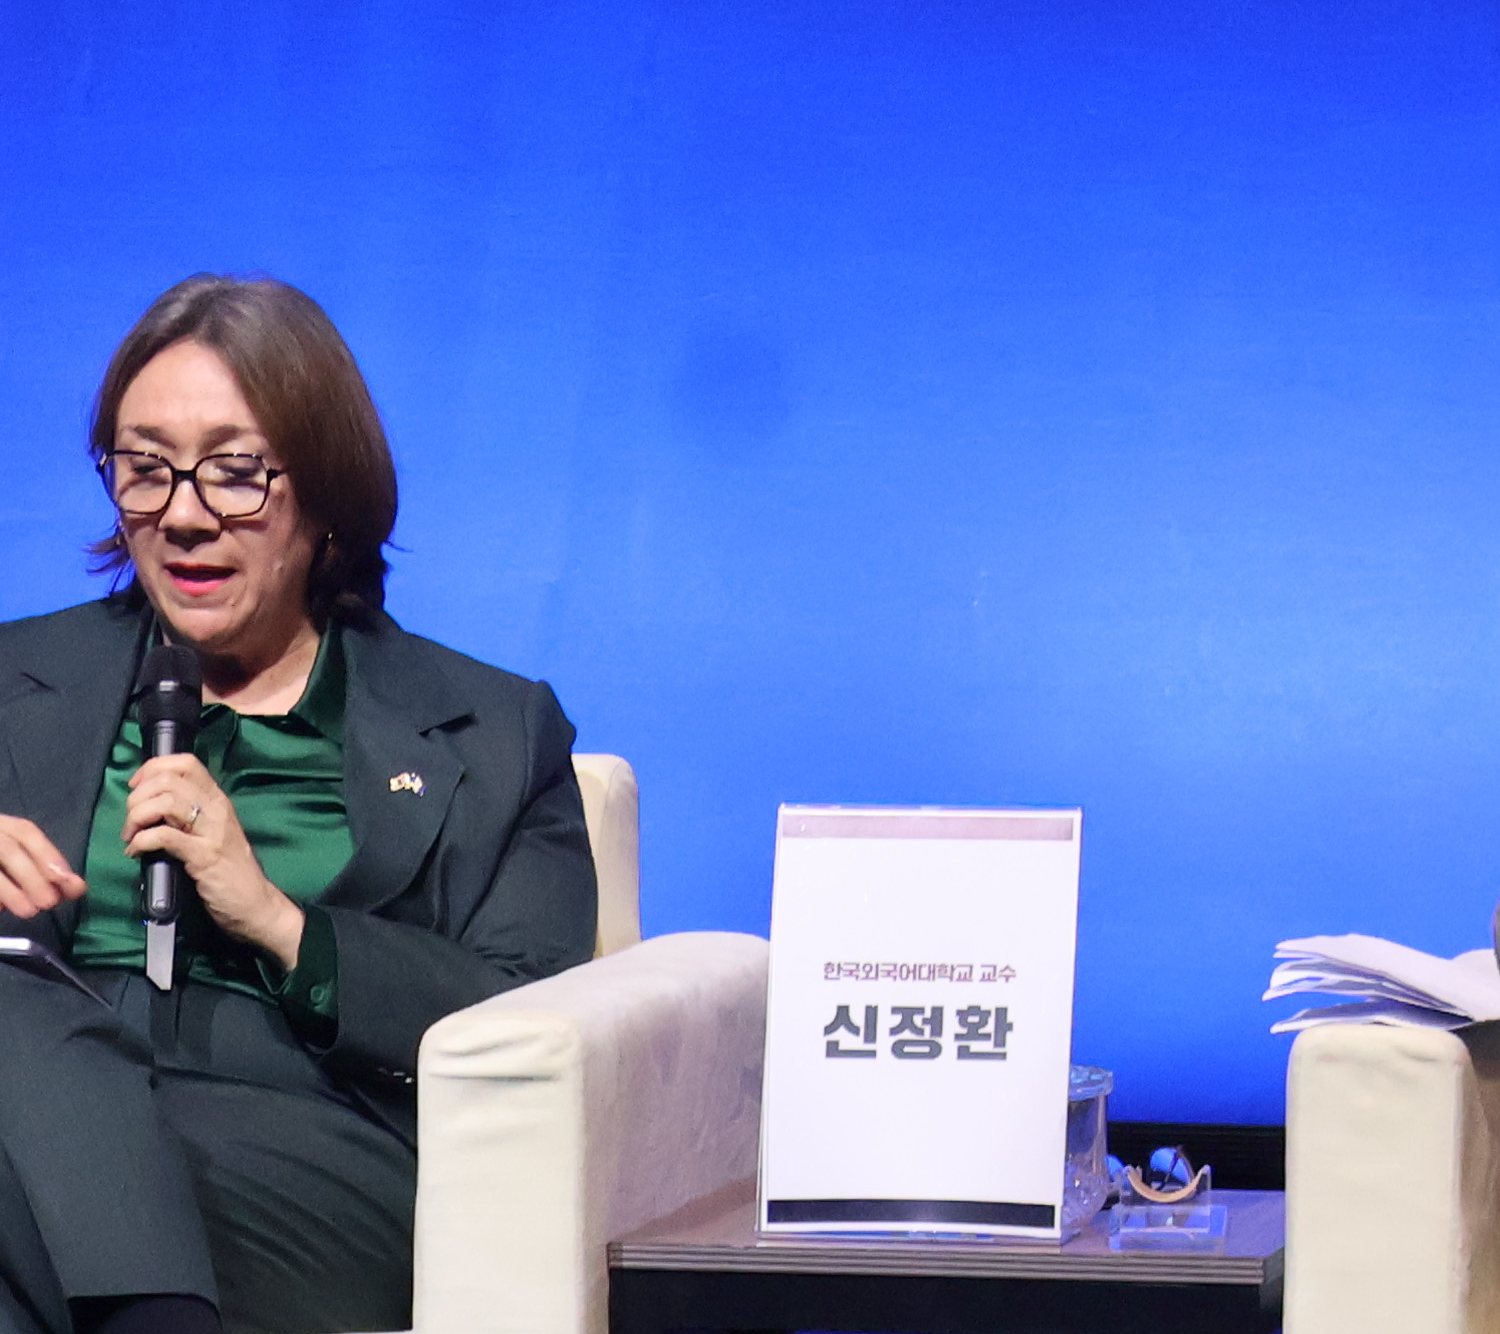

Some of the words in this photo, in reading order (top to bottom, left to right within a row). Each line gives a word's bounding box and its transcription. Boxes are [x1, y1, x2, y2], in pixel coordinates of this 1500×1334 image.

[823, 961, 975, 983] 한국외국어대학교
[979, 964, 1018, 984] 교수
[823, 1004, 1015, 1062] 신정환
